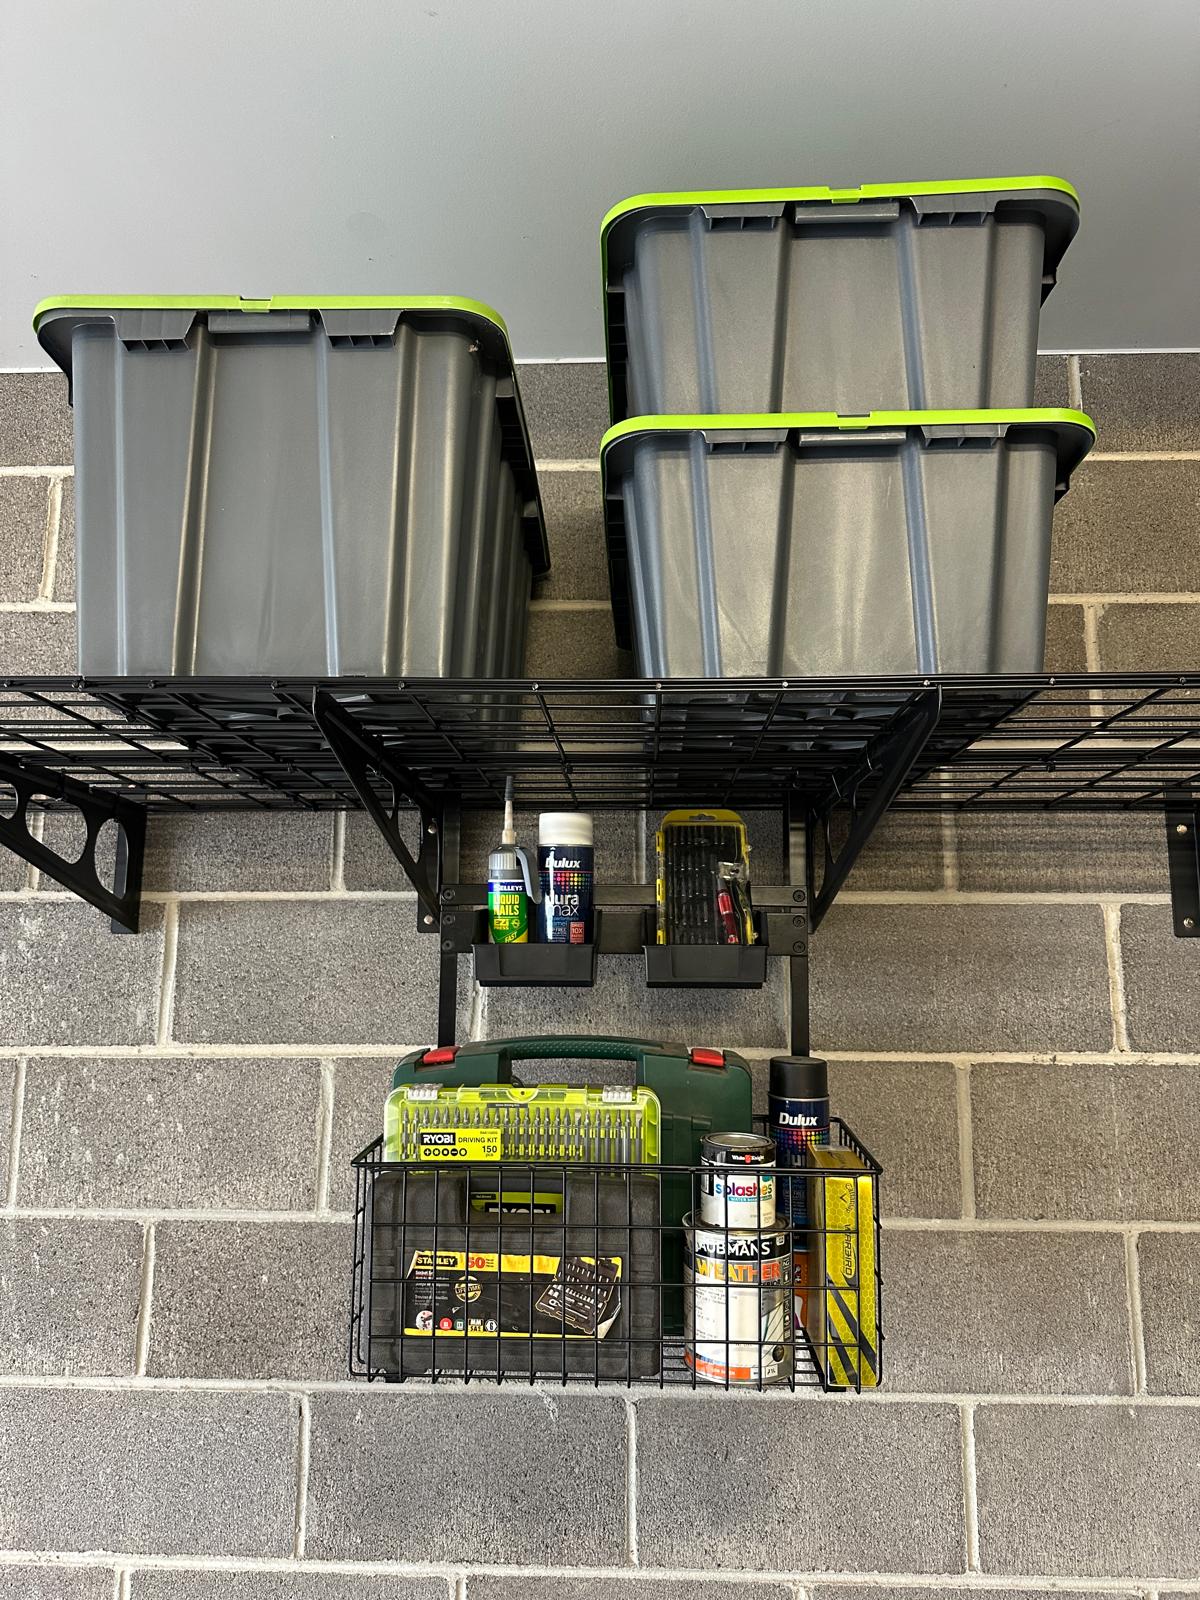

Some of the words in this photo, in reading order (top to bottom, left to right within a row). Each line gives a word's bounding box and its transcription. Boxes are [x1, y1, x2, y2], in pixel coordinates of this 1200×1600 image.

[545, 857, 580, 868] Dulux
[494, 894, 519, 904] LIQUID
[494, 905, 519, 915] NAILS
[505, 931, 518, 943] FAST
[779, 1112, 818, 1126] Dulux
[423, 1135, 454, 1144] RYOBI
